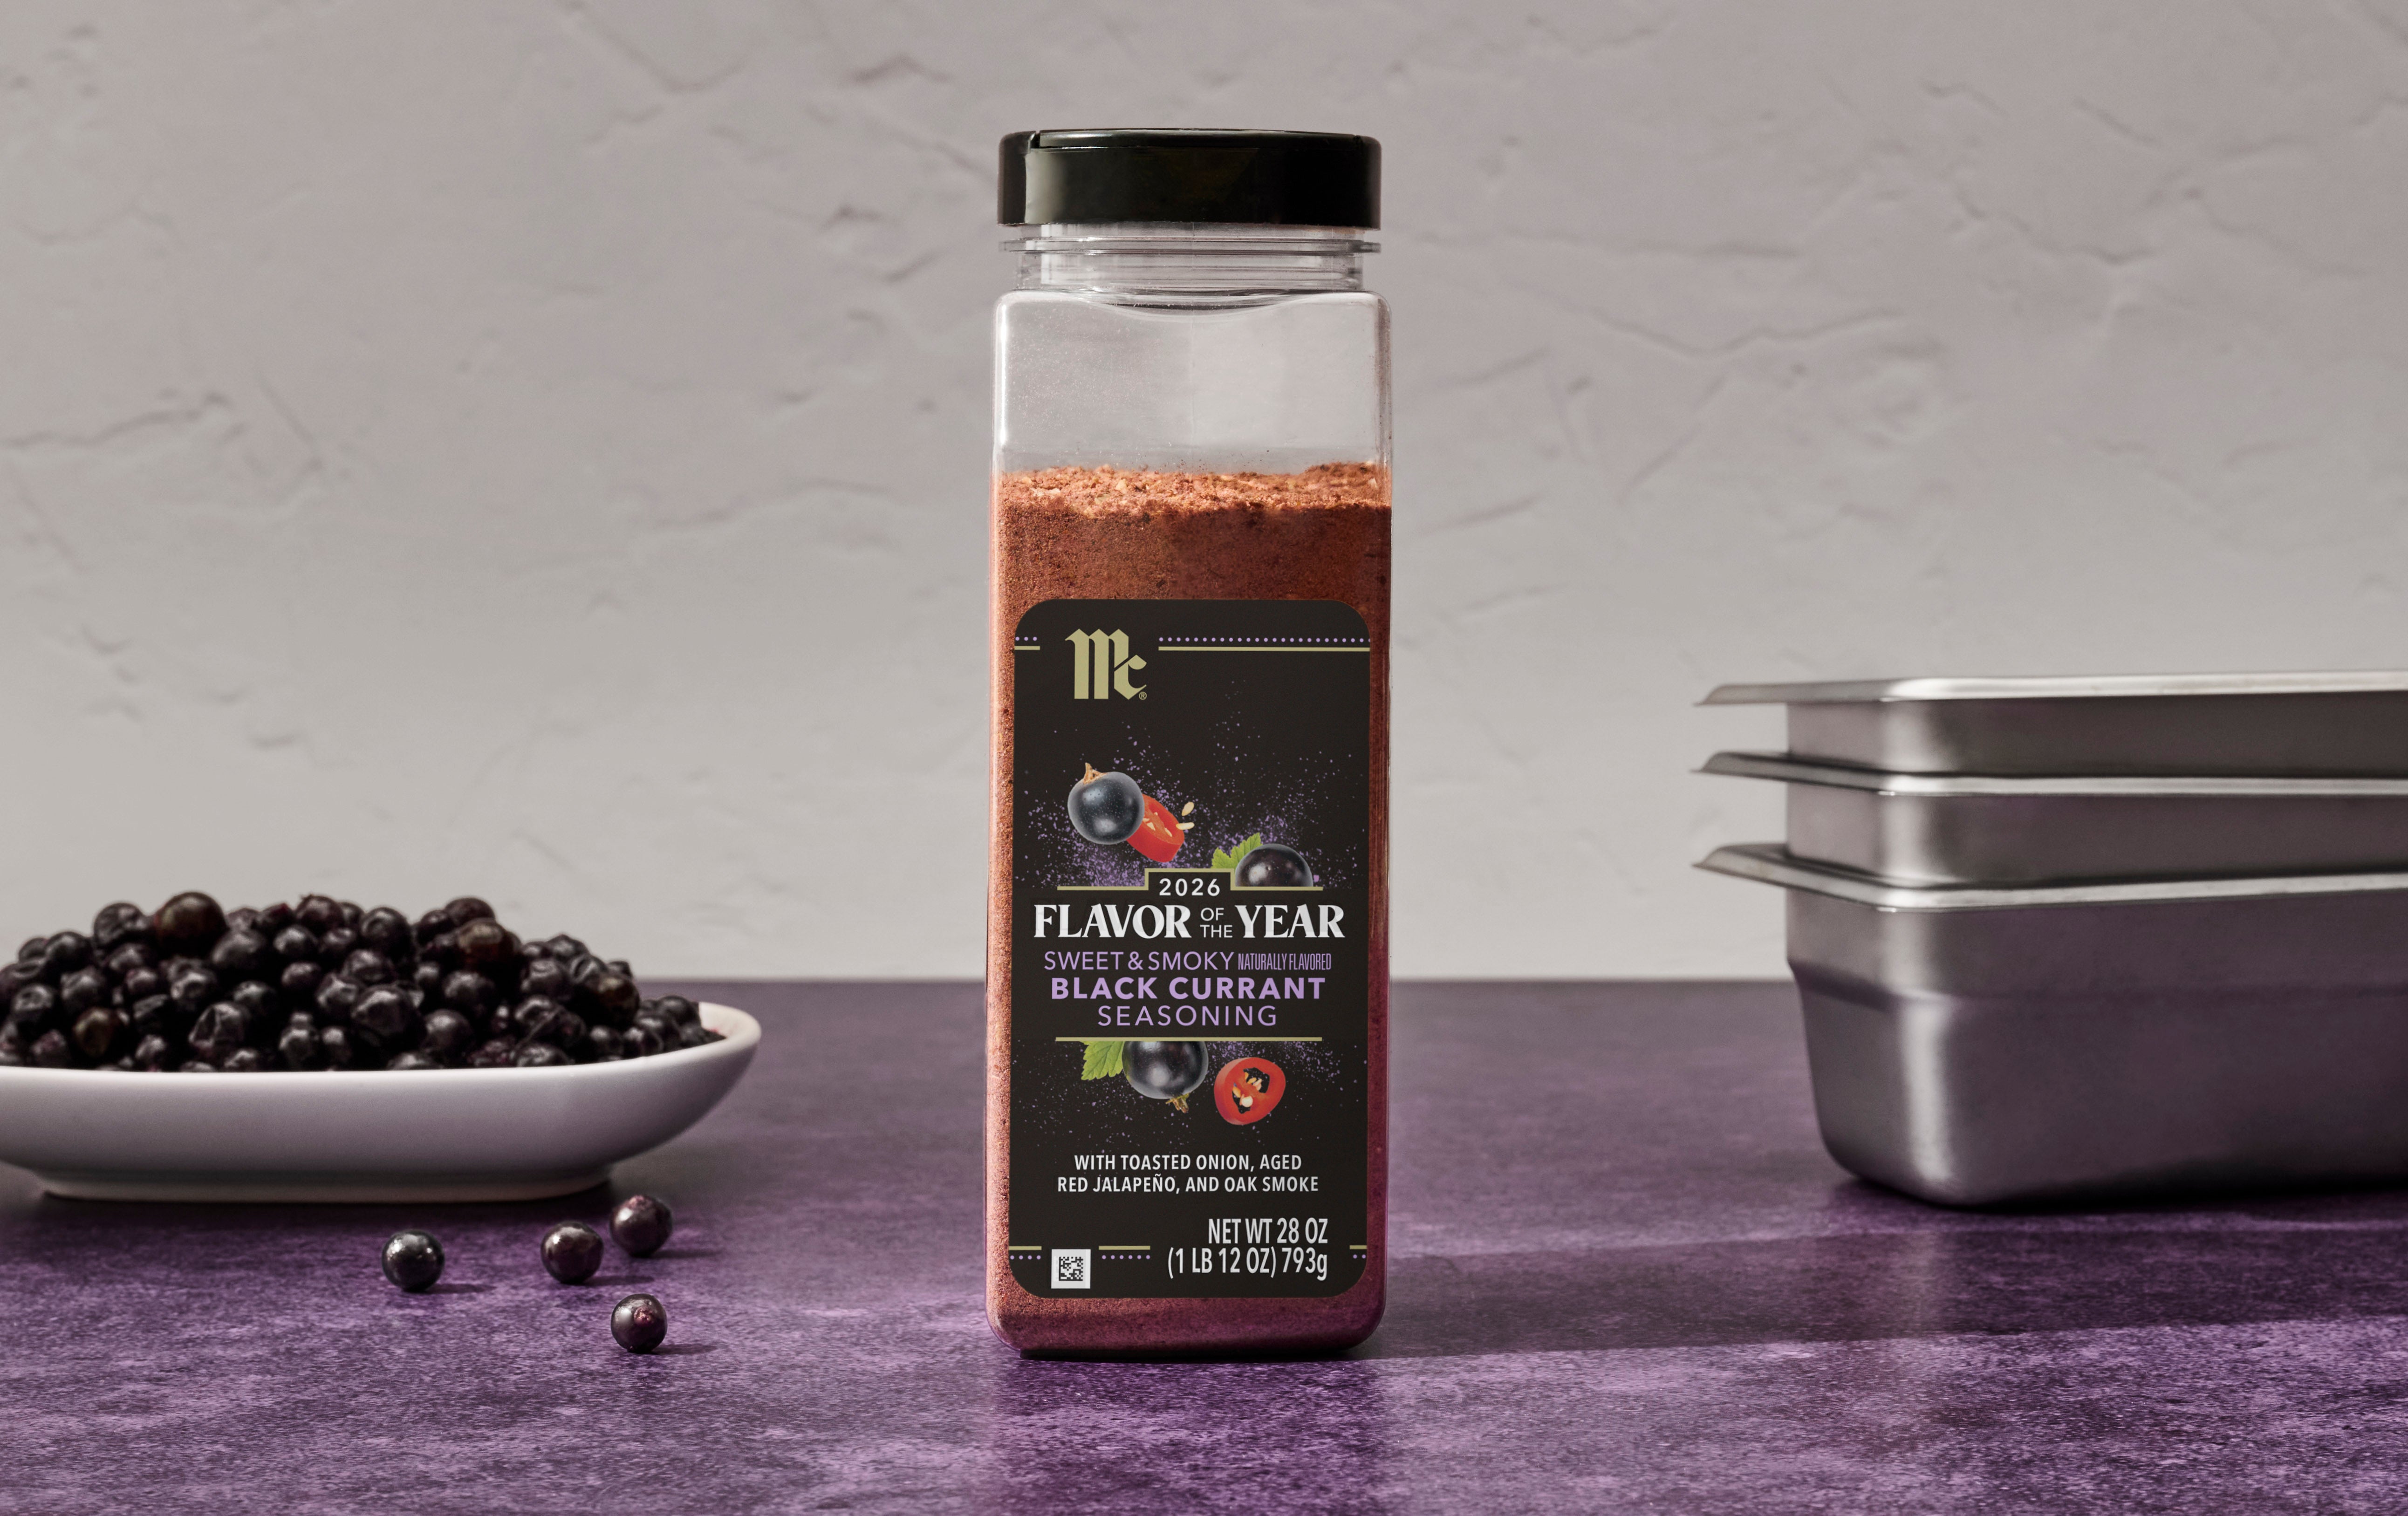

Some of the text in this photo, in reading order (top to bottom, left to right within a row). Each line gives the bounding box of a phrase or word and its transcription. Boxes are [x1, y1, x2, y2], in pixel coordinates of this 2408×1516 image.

[1159, 878, 1220, 897] 2026
[1033, 903, 1346, 939] FLAVOR OF THE YEAR
[1044, 951, 1124, 970] SWEET
[1148, 951, 1234, 971] SMOKY
[1238, 953, 1287, 970] NATURALLY
[1289, 953, 1332, 970] FLAVORED
[1052, 977, 1326, 1000] BLACK CURRANT
[1098, 1005, 1276, 1026] SEASONING
[1074, 1154, 1302, 1172] WITH TOASTED ONION, AGED
[1058, 1173, 1319, 1195] RED JALAPEÑO, AND OAK SMOKE
[1208, 1217, 1328, 1244] NET WT 28 OZ
[1168, 1246, 1327, 1281] (1 LB 12 OZ) 793g
